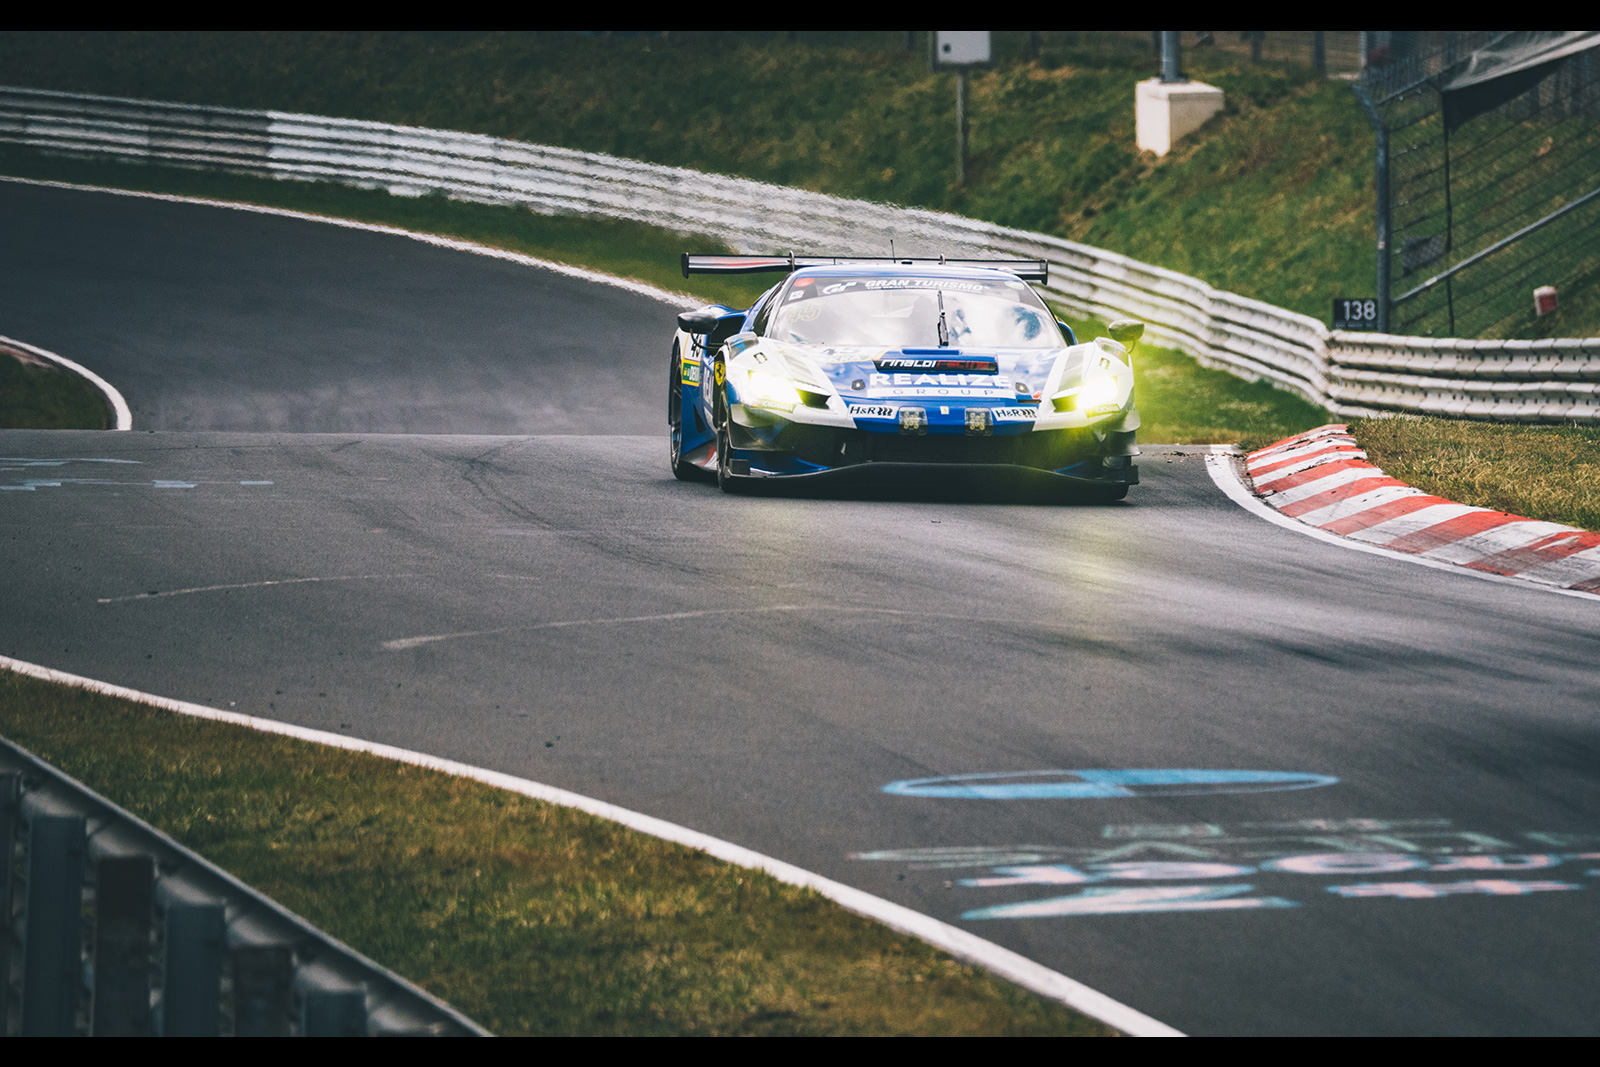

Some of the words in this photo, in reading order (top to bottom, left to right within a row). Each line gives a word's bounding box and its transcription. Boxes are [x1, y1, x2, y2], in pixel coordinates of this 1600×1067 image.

[865, 279, 910, 288] GRAN
[914, 279, 984, 291] TURISMO
[783, 301, 825, 323] 45
[1343, 300, 1376, 321] 138
[869, 373, 1013, 387] REALIZE
[893, 388, 995, 396] GROUP
[849, 406, 876, 415] H&R
[996, 408, 1022, 417] H&R
